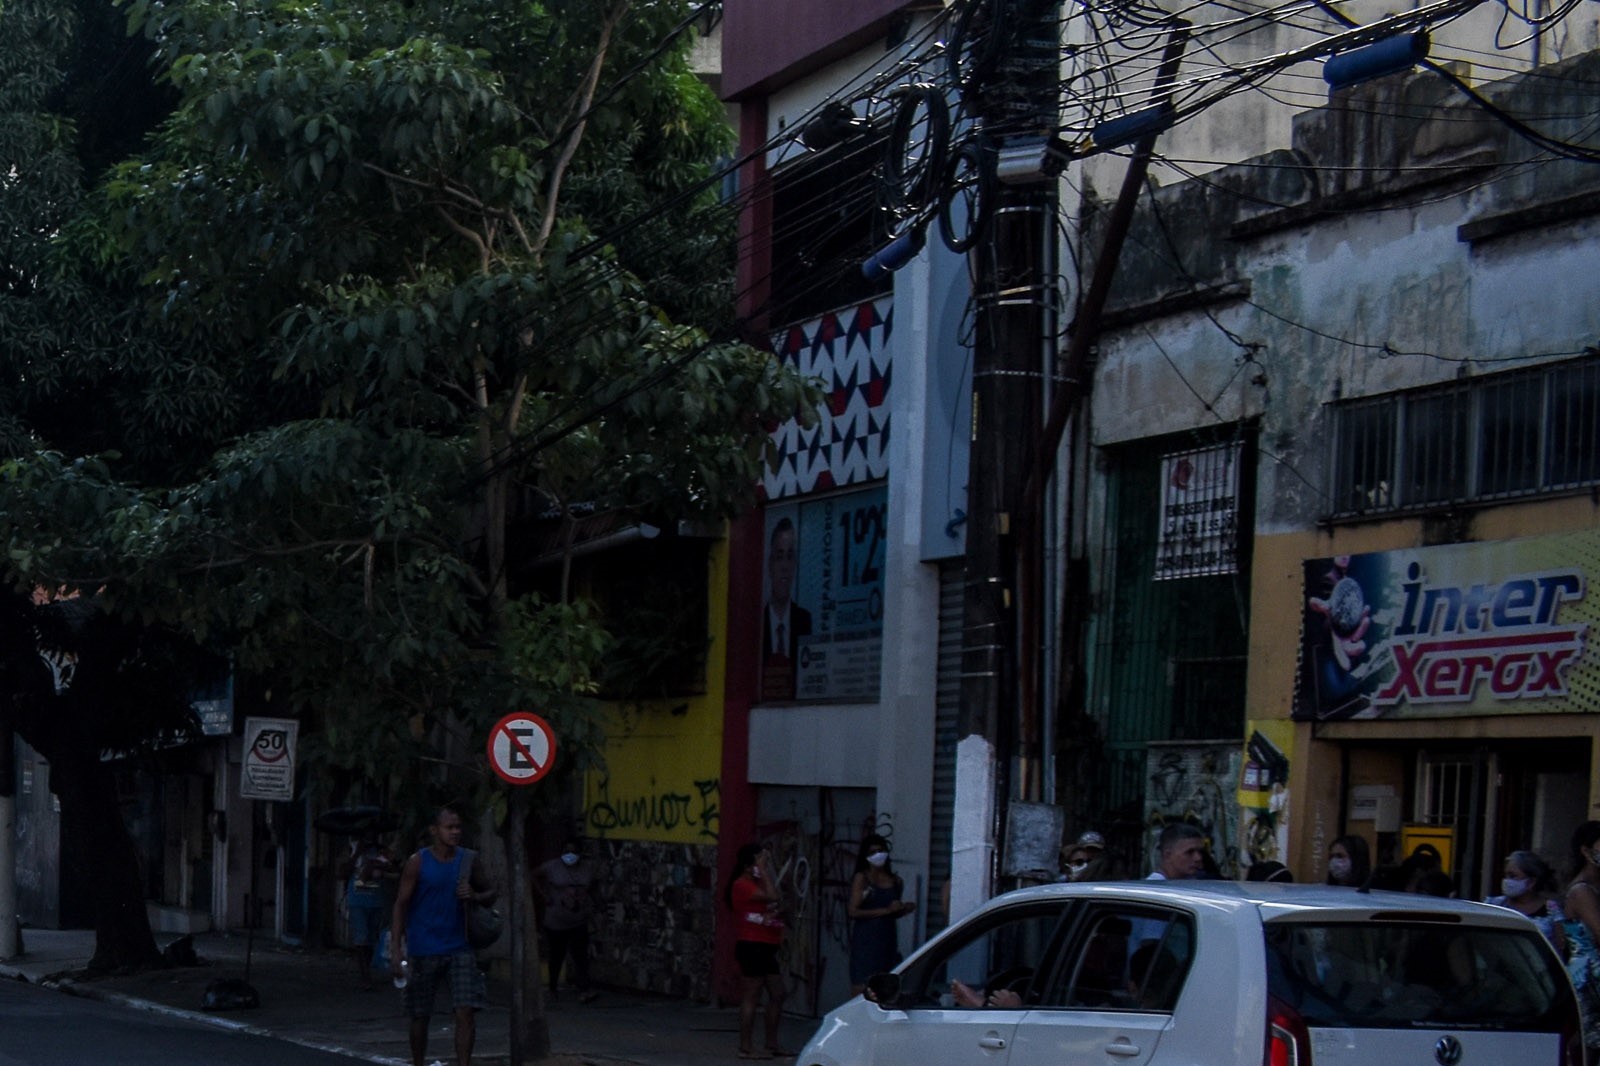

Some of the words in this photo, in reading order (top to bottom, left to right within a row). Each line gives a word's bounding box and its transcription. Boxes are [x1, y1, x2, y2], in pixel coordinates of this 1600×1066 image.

[1394, 561, 1580, 636] inter
[259, 731, 283, 750] 50
[510, 728, 533, 769] E
